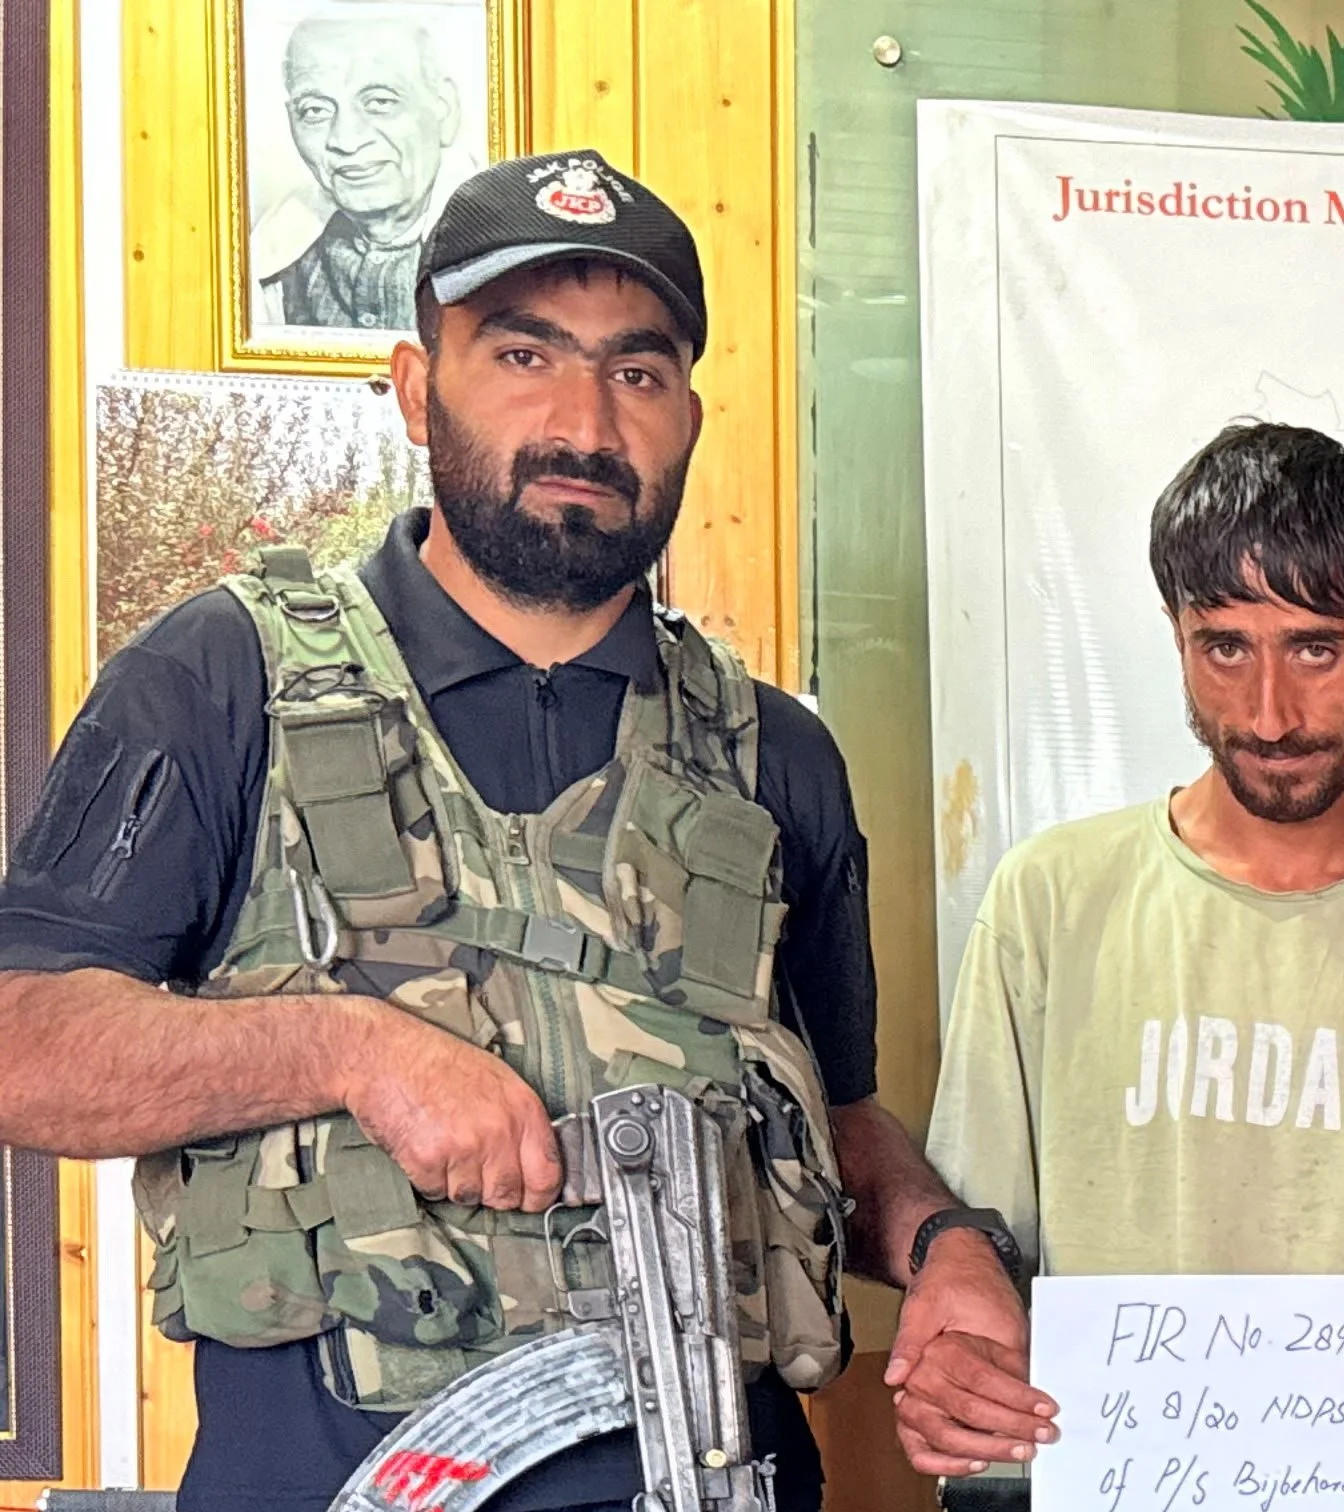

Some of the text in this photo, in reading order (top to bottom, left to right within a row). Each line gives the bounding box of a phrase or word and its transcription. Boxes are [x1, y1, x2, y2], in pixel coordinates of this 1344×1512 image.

[1053, 175, 1310, 224] Jurisdiction
[1106, 1301, 1187, 1366] FIR
[1162, 1385, 1240, 1440] 8/20
